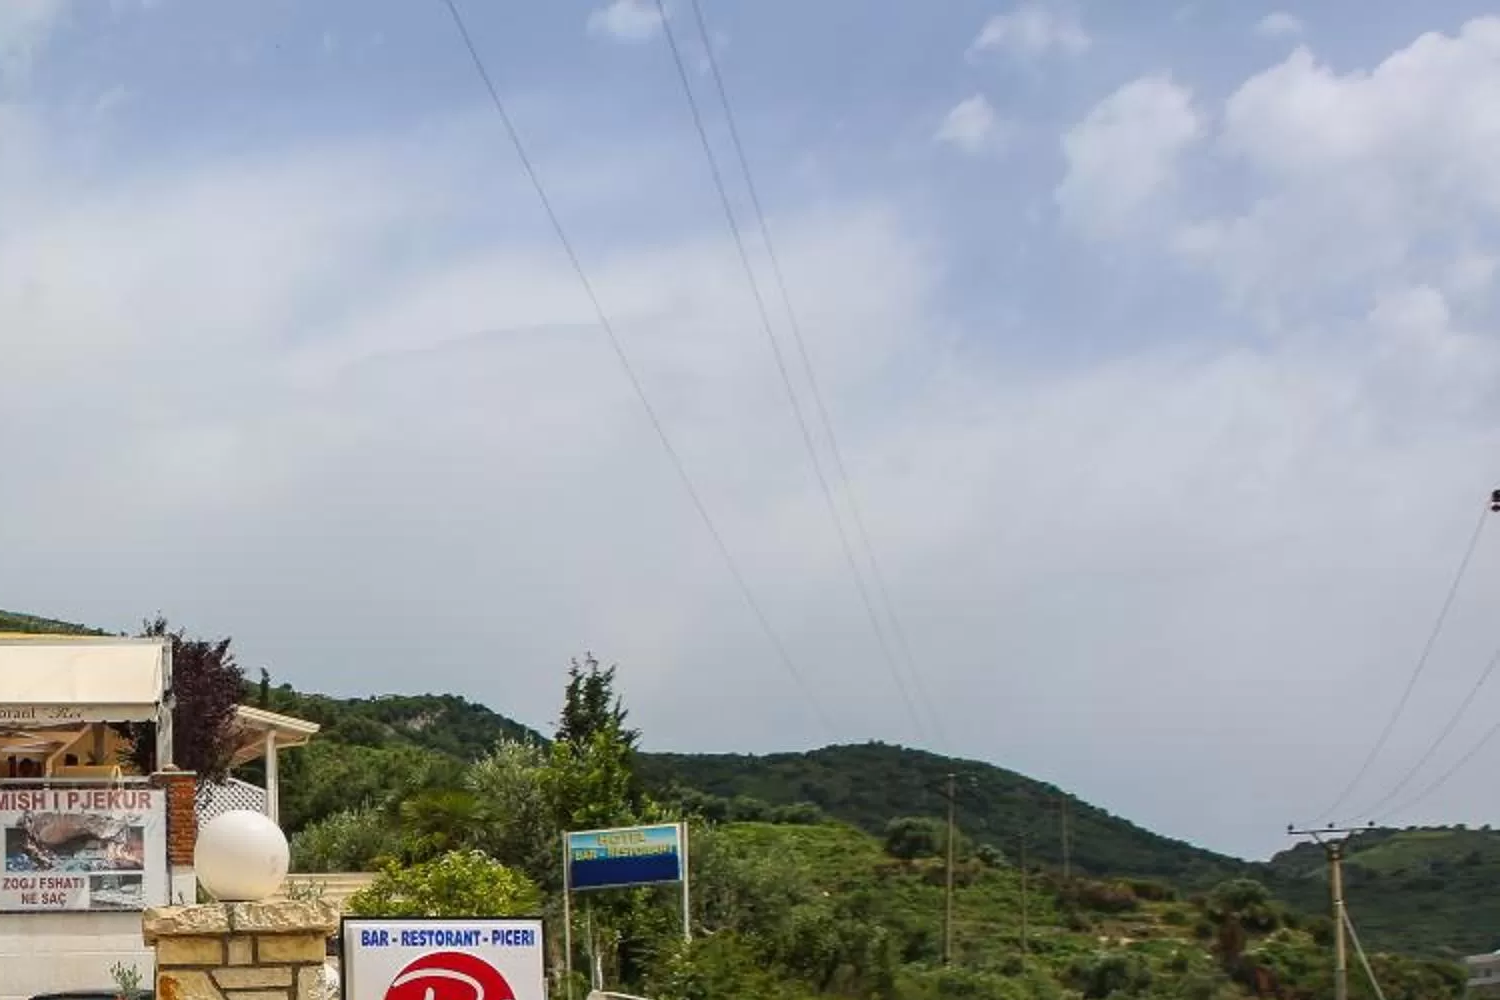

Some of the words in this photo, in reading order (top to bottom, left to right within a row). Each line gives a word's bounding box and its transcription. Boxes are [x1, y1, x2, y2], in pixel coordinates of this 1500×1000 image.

[53, 793, 59, 809] I
[67, 791, 151, 810] PJEKUR
[3, 877, 35, 890] ZOGJ
[39, 877, 85, 889] FSHATI
[361, 930, 389, 947] BAR
[400, 930, 481, 947] RESTORANT
[491, 929, 535, 946] PICERI
